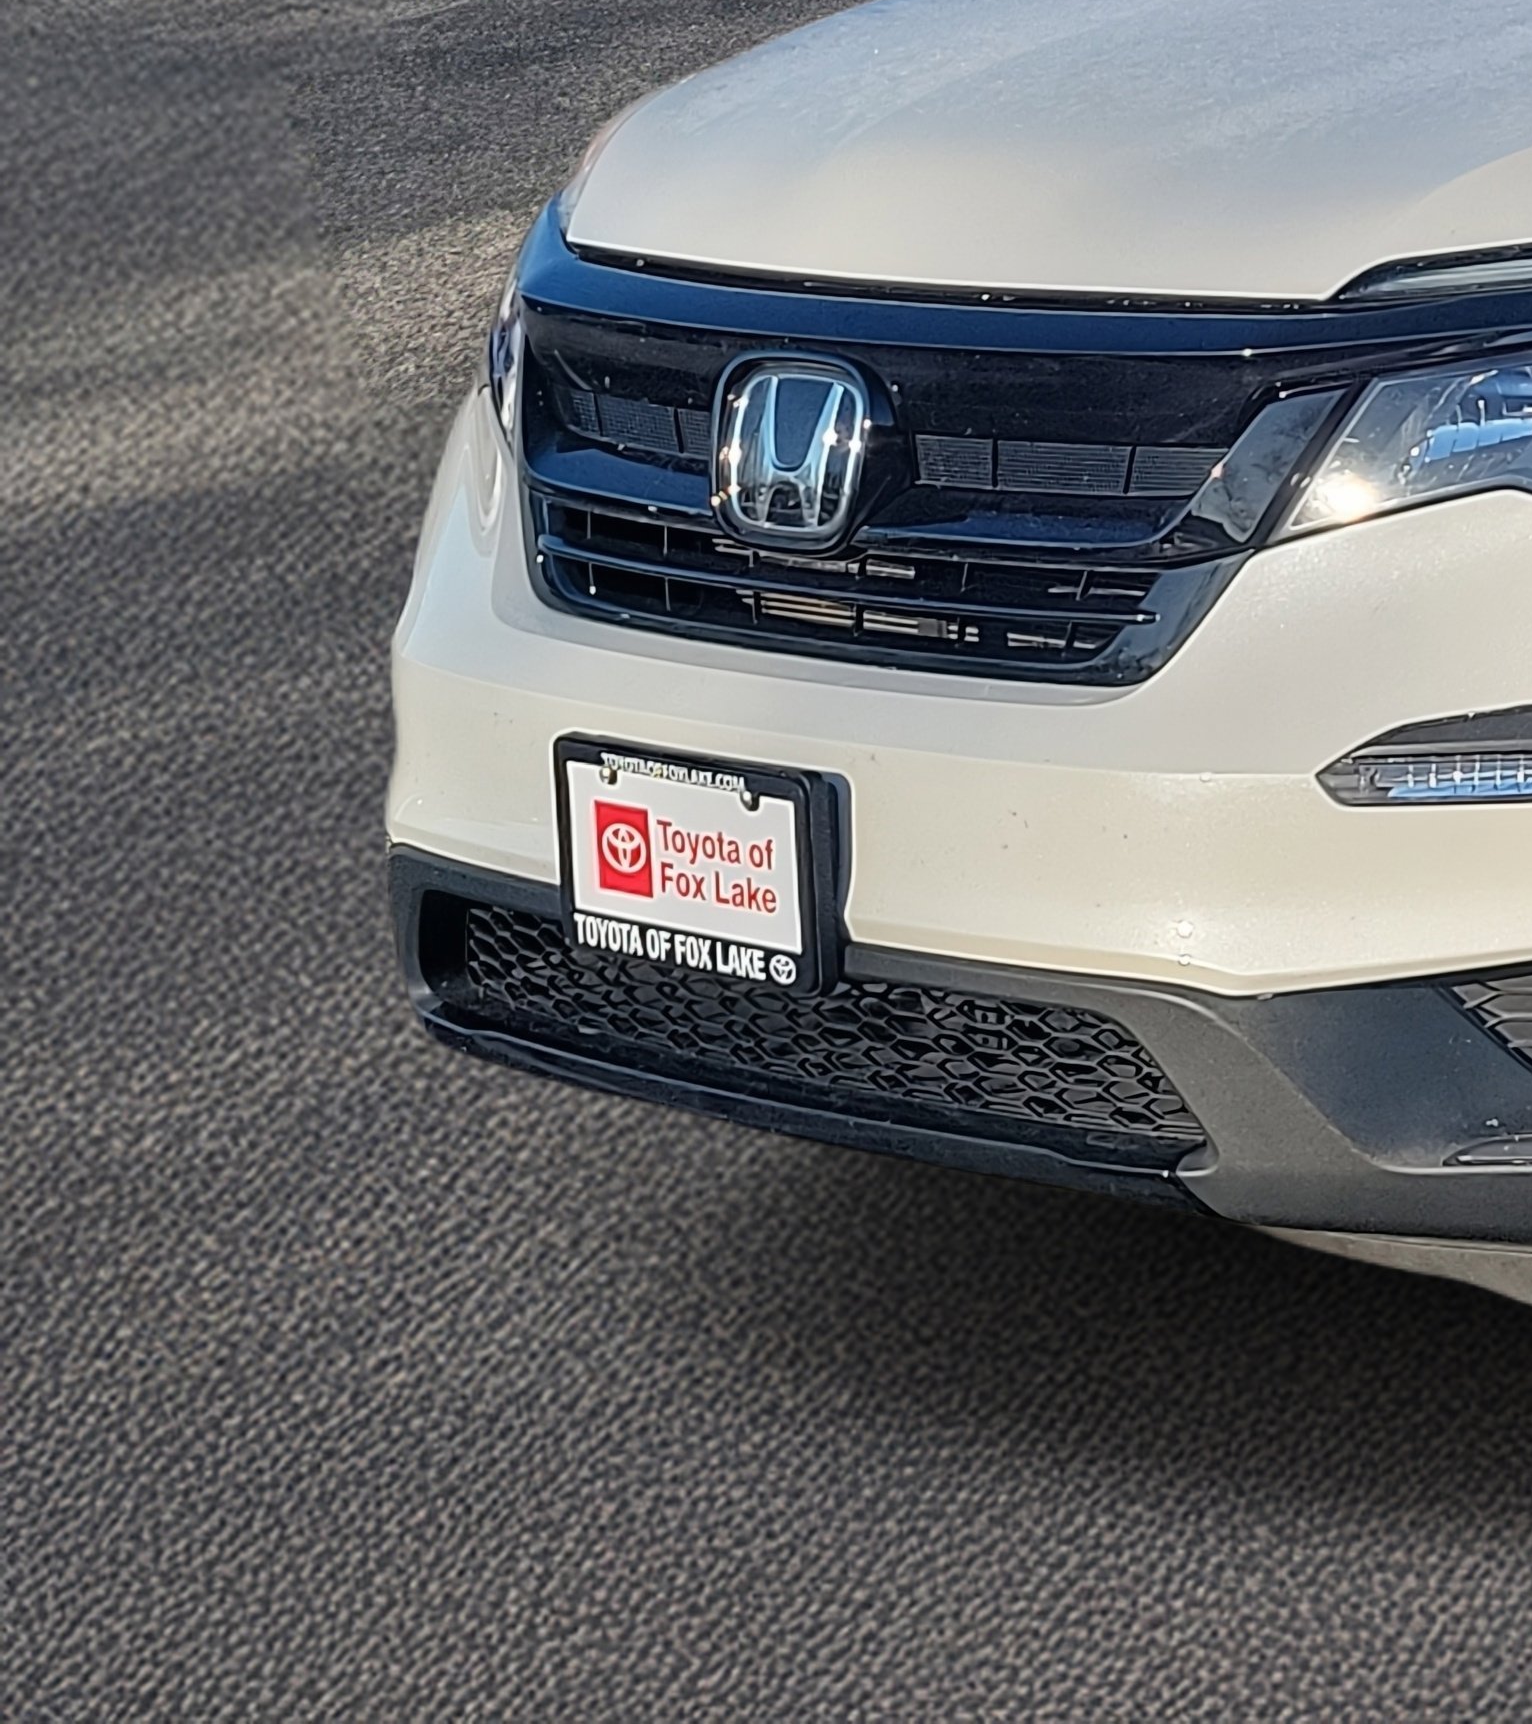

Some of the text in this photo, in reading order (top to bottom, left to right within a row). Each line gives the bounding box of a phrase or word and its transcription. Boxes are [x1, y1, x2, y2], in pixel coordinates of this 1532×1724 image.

[656, 819, 774, 870] Toyota of
[660, 861, 777, 914] Fox Lake
[573, 912, 767, 981] TOYOTA OF FOX LAKE
